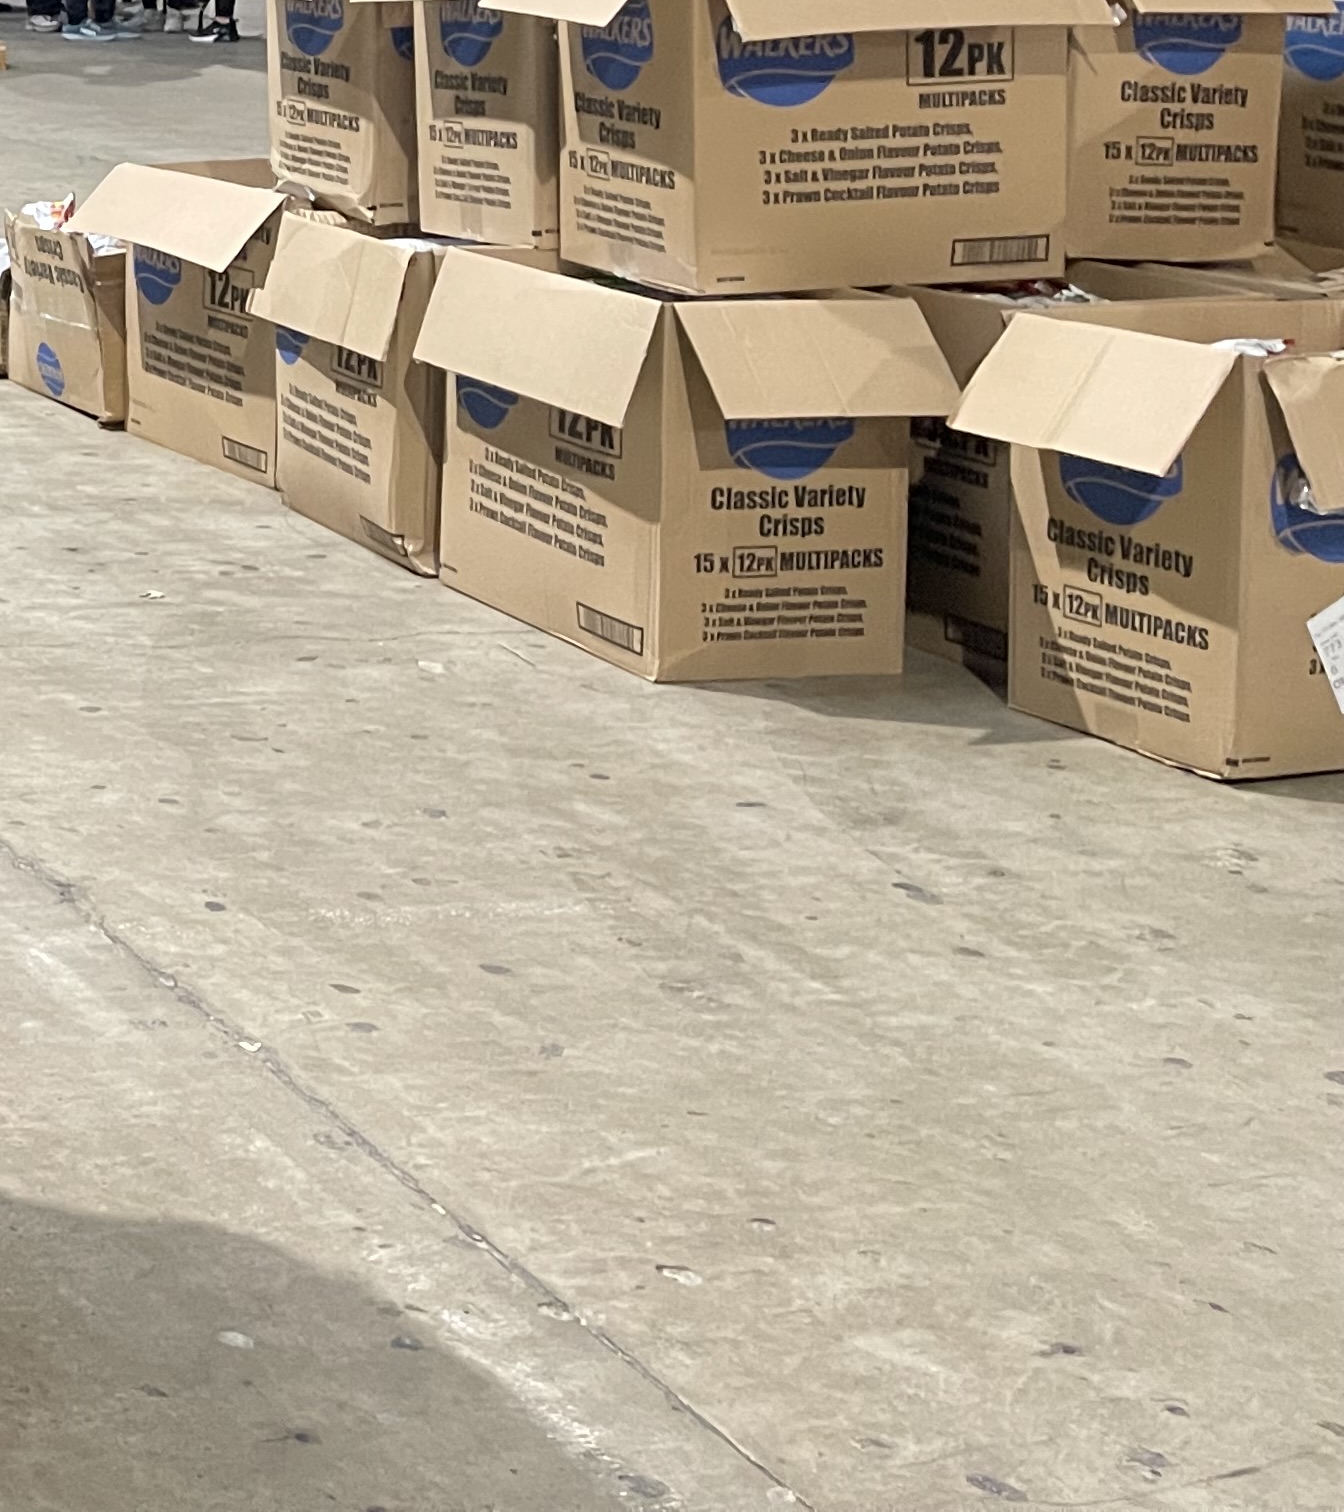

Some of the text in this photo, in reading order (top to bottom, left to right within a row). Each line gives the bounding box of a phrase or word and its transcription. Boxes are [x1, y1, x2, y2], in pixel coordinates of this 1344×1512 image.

[915, 28, 1006, 78] 12PK
[918, 89, 1006, 109] MULTIPACKS
[1121, 80, 1248, 108] Classic Variety
[574, 92, 661, 129] Classic Variety
[1160, 108, 1214, 132] Crisps
[599, 122, 636, 149] Crisps
[759, 150, 767, 165] 3
[1103, 141, 1122, 160] 15
[1175, 143, 1259, 164] MULTIPACKS
[611, 160, 675, 190] MULTIPACKS
[764, 170, 772, 185] 3
[762, 190, 770, 205] 3
[711, 484, 866, 511] Classic Variety
[759, 513, 825, 538] Crisps
[693, 548, 884, 574] 15 x 12PK MULTIPACKS
[1047, 517, 1194, 578] Classic Variety
[1086, 556, 1150, 596] Crisps
[1032, 583, 1049, 606] 15
[1067, 593, 1100, 622] 12PK
[1104, 602, 1210, 651] MULTIPACKS
